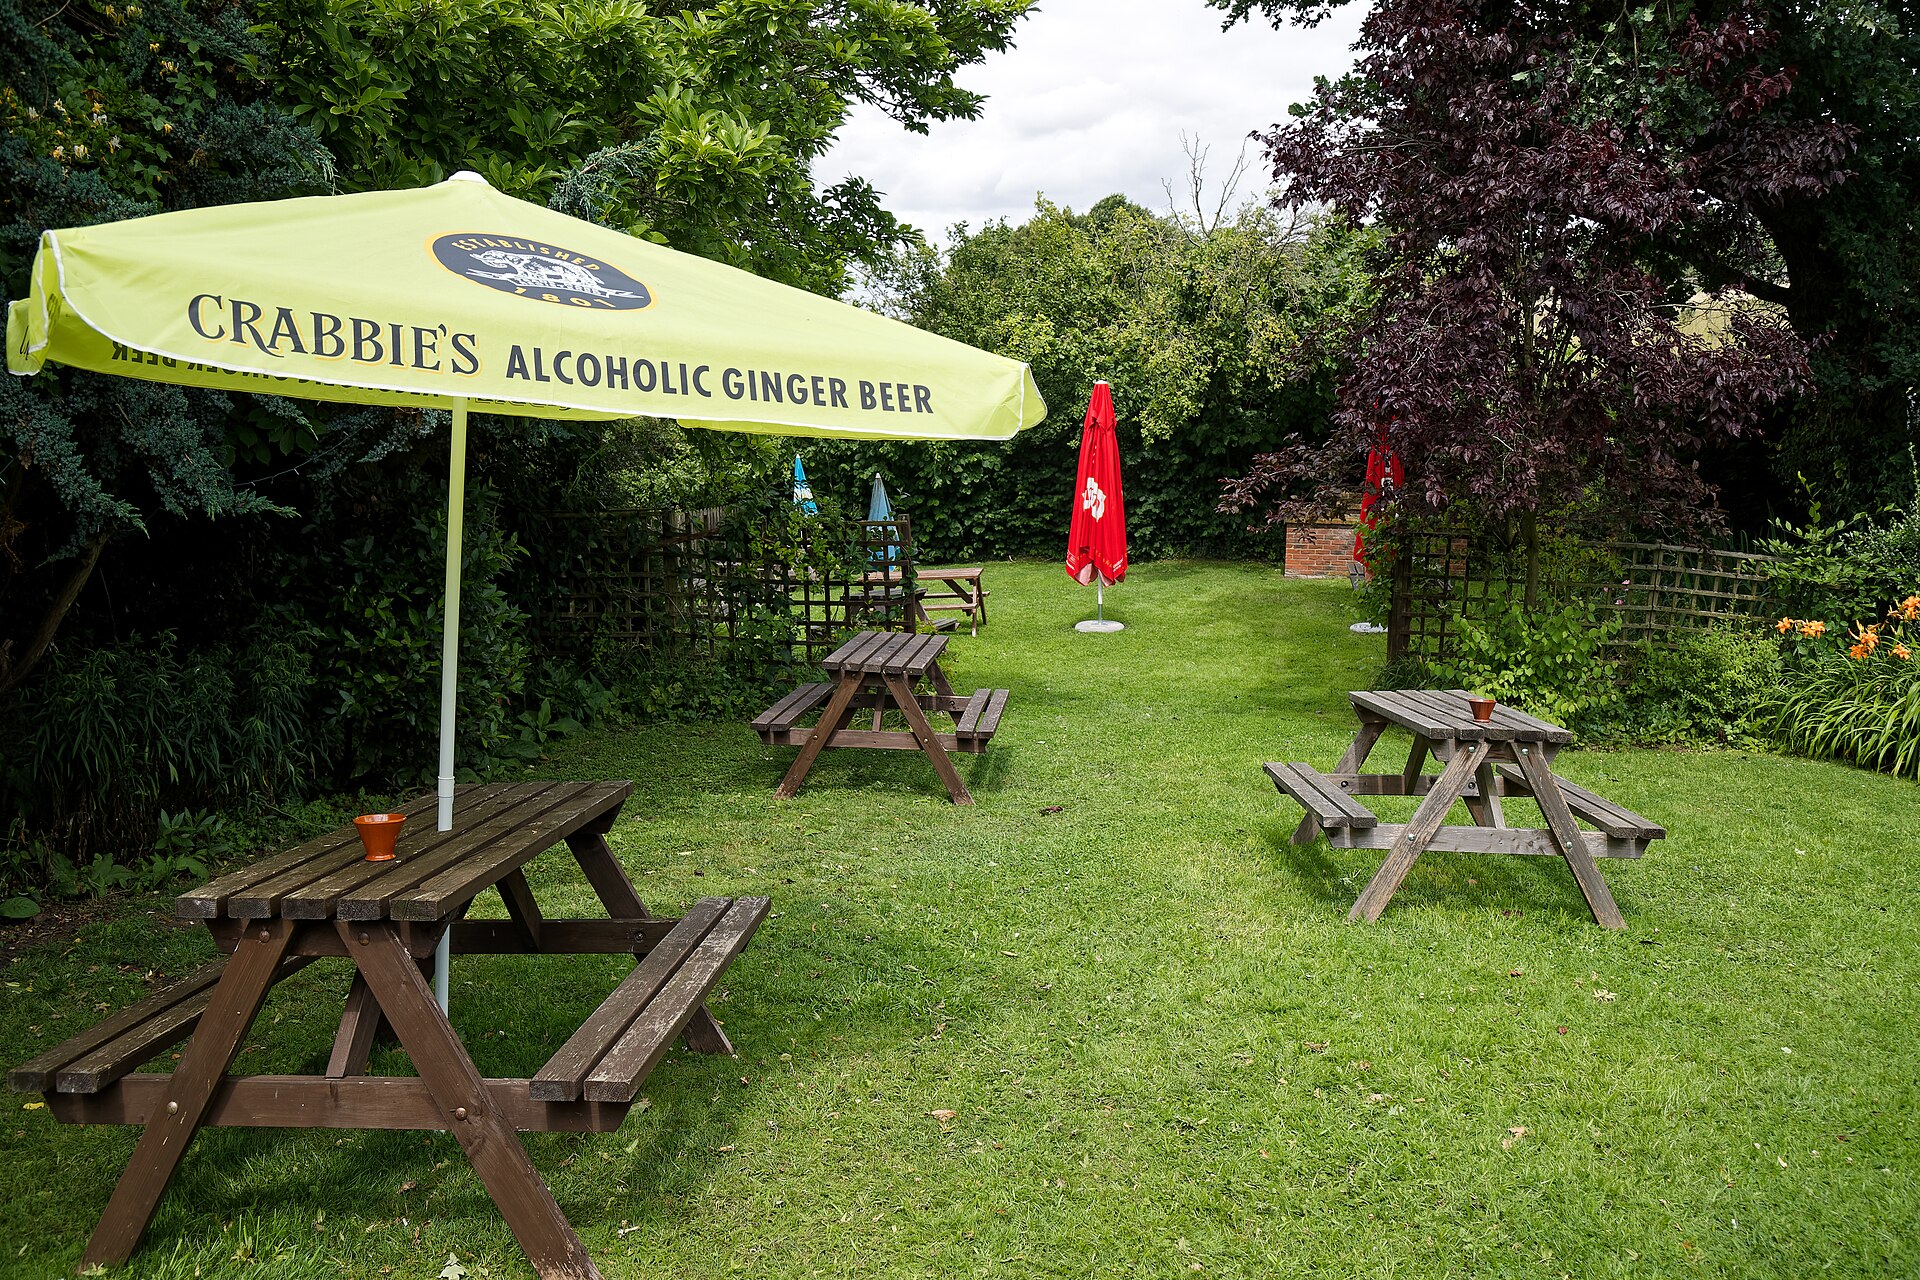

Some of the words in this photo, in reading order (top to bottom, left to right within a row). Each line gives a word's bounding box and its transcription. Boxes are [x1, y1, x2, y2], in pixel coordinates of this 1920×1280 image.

[451, 238, 601, 271] ESTABLISHED
[514, 286, 616, 308] 1801
[187, 294, 480, 376] CRABBIE'S
[505, 344, 713, 398] ALCOHOLIC
[722, 367, 850, 409] GINGER
[858, 380, 934, 414] BEER
